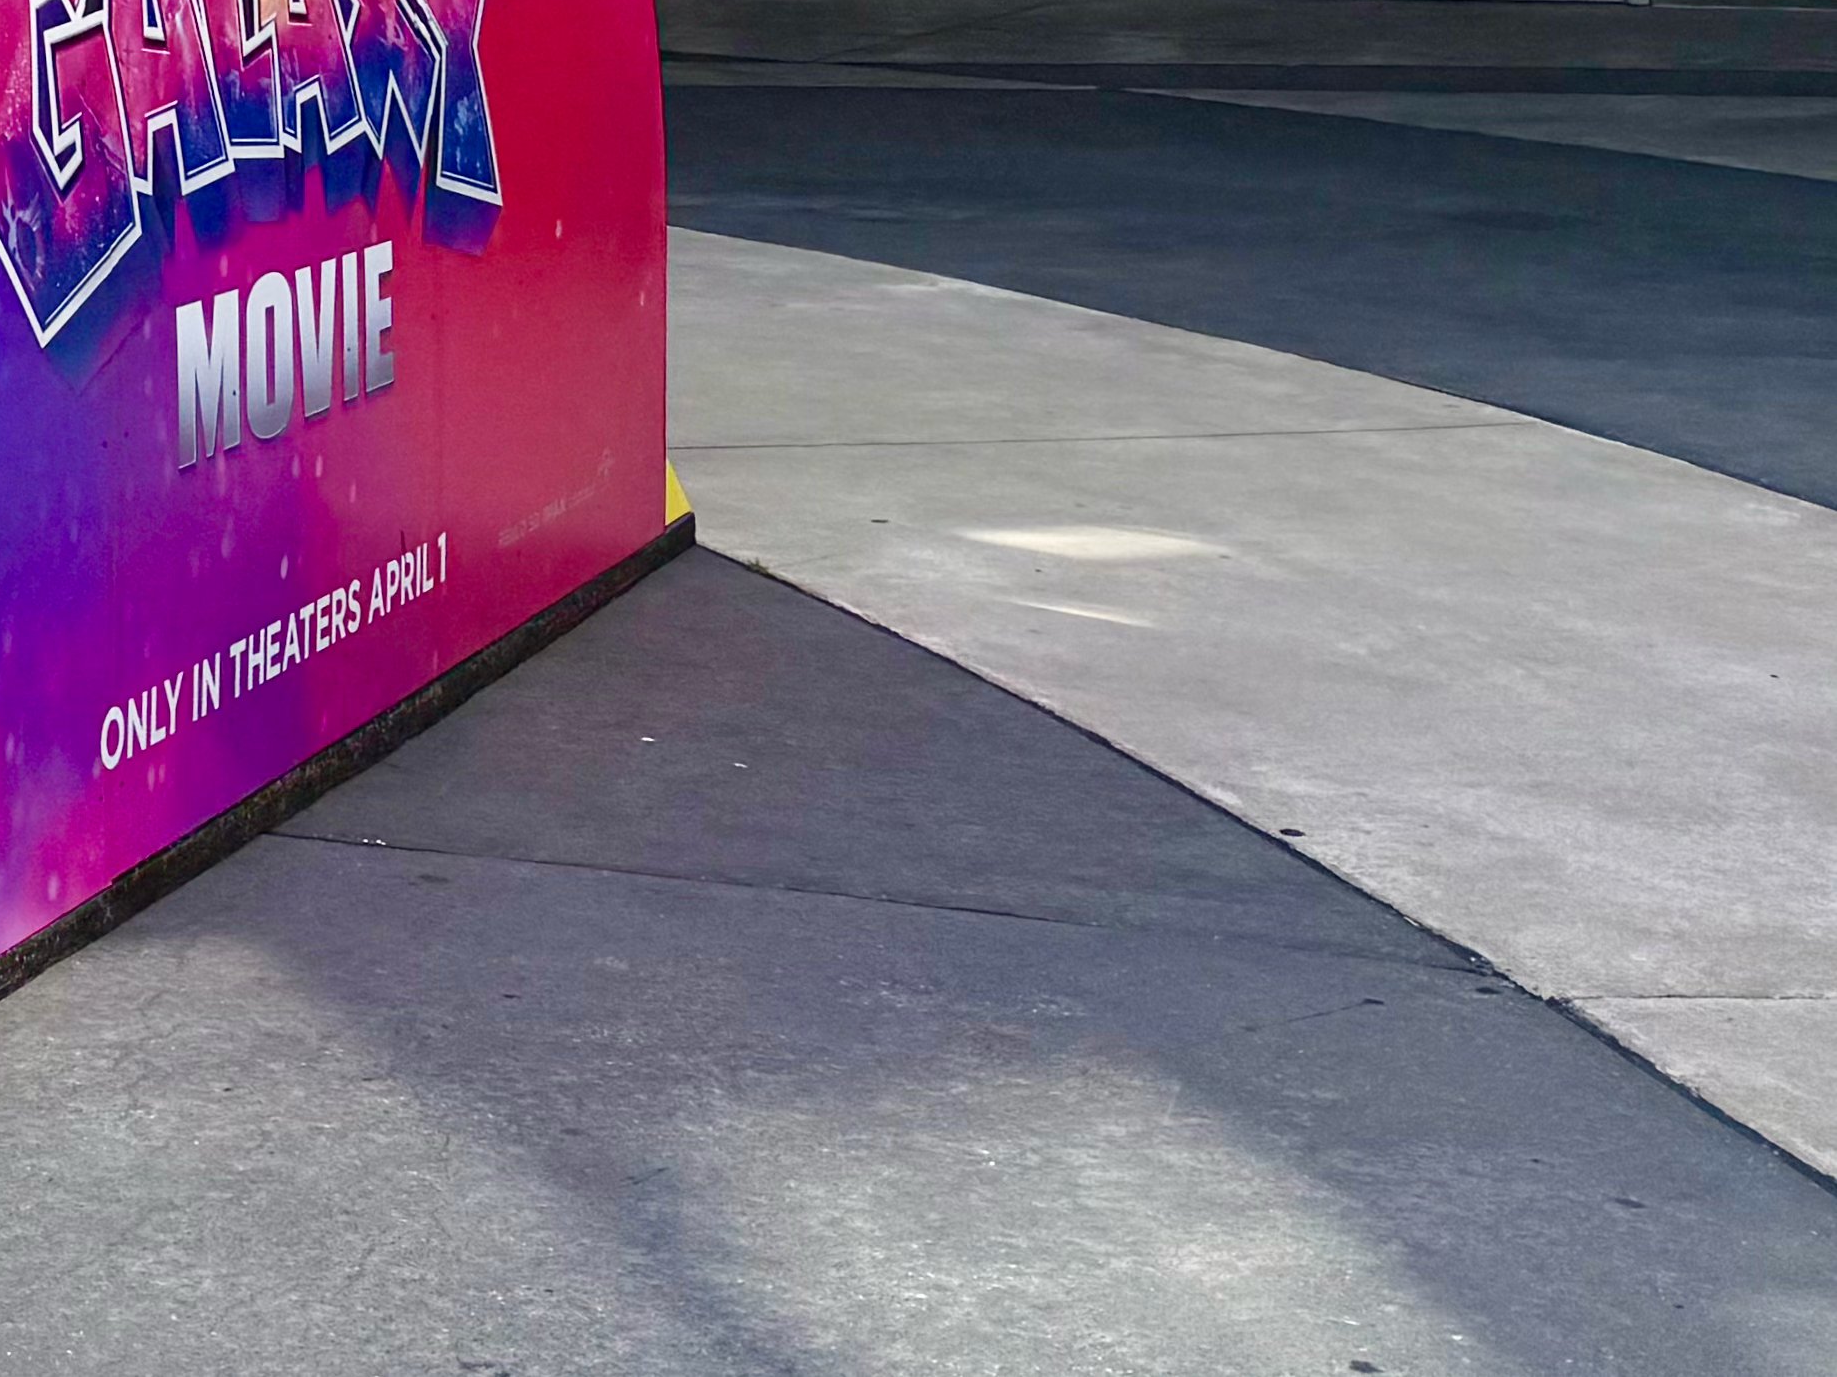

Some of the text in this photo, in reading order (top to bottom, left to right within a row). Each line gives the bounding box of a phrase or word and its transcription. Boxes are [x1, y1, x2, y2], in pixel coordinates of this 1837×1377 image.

[176, 241, 394, 470] MOVIE
[100, 532, 447, 770] ONLY IN THEATERS APRIL 1
